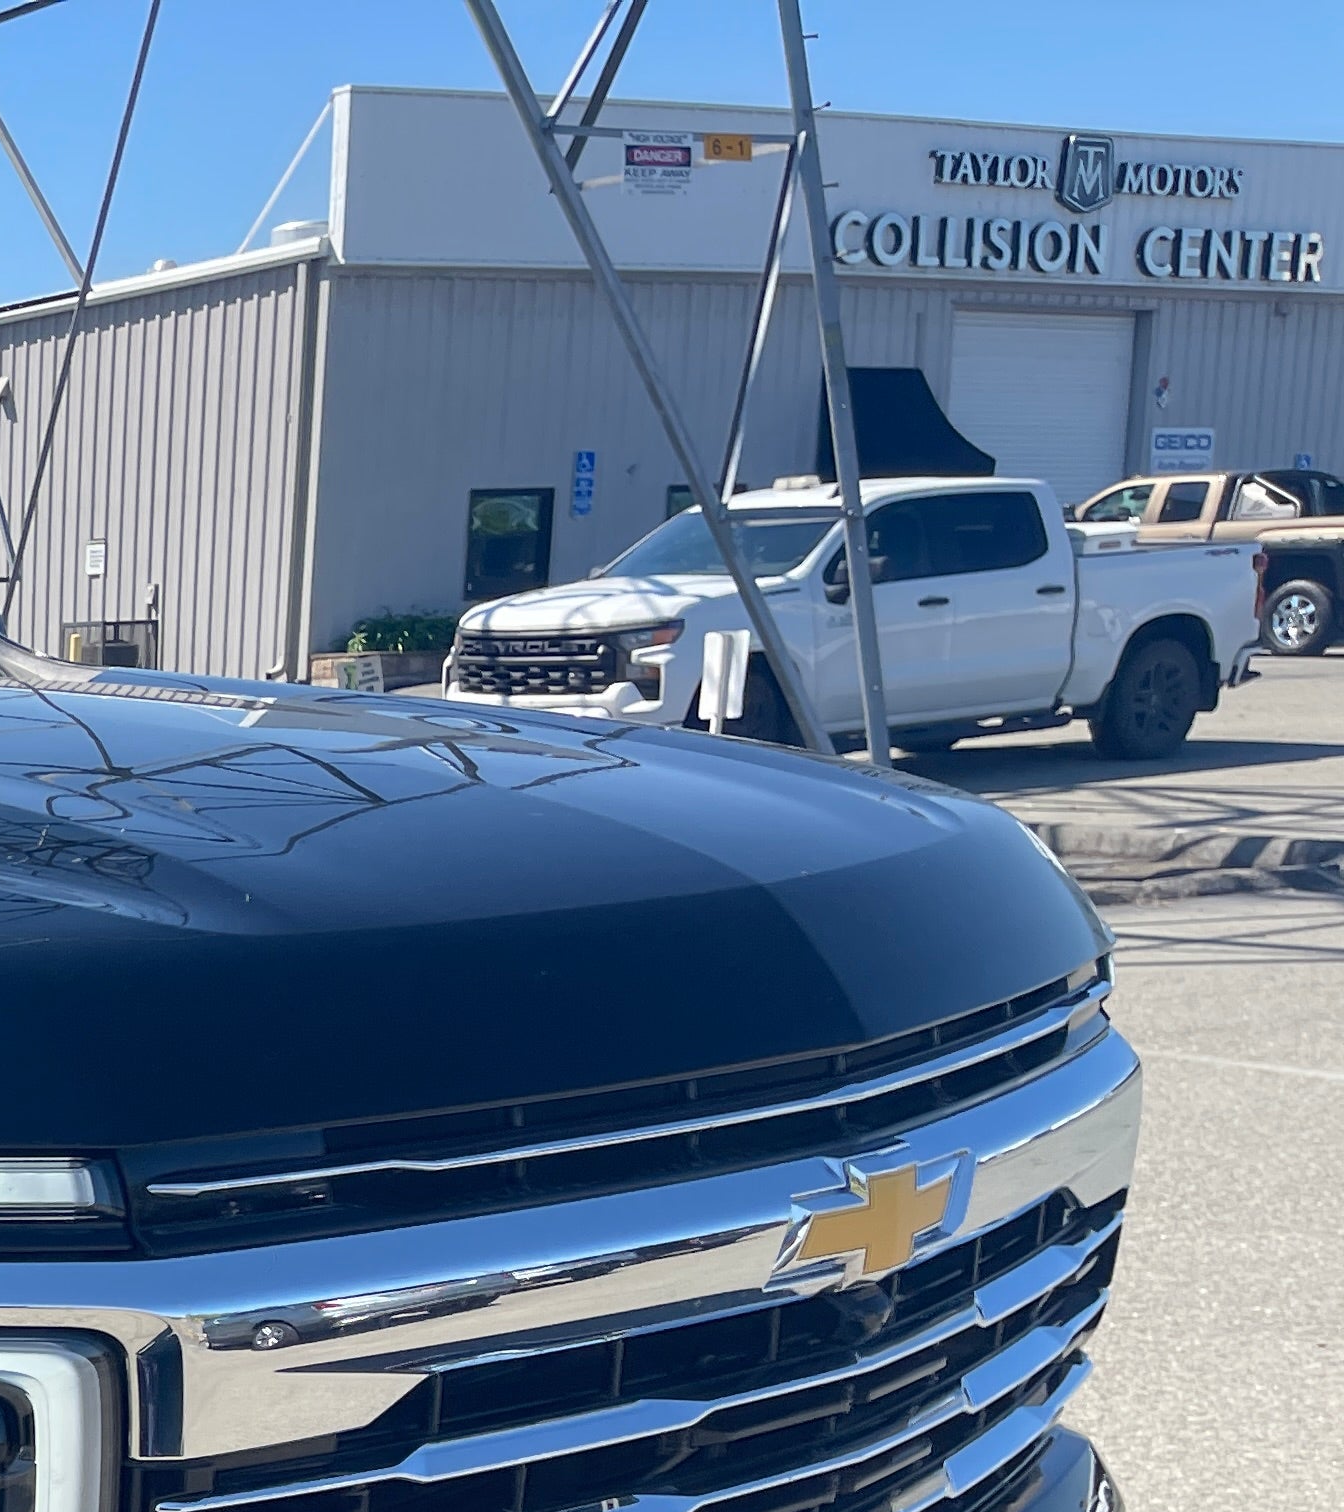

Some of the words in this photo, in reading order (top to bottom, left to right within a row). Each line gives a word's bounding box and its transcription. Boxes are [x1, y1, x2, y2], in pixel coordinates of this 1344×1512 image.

[930, 149, 1055, 190] TAYLOR
[1115, 161, 1244, 198] MOTORS
[832, 209, 1109, 277] COLLISION
[1138, 226, 1324, 284] CENTER
[1155, 434, 1212, 450] GEICO
